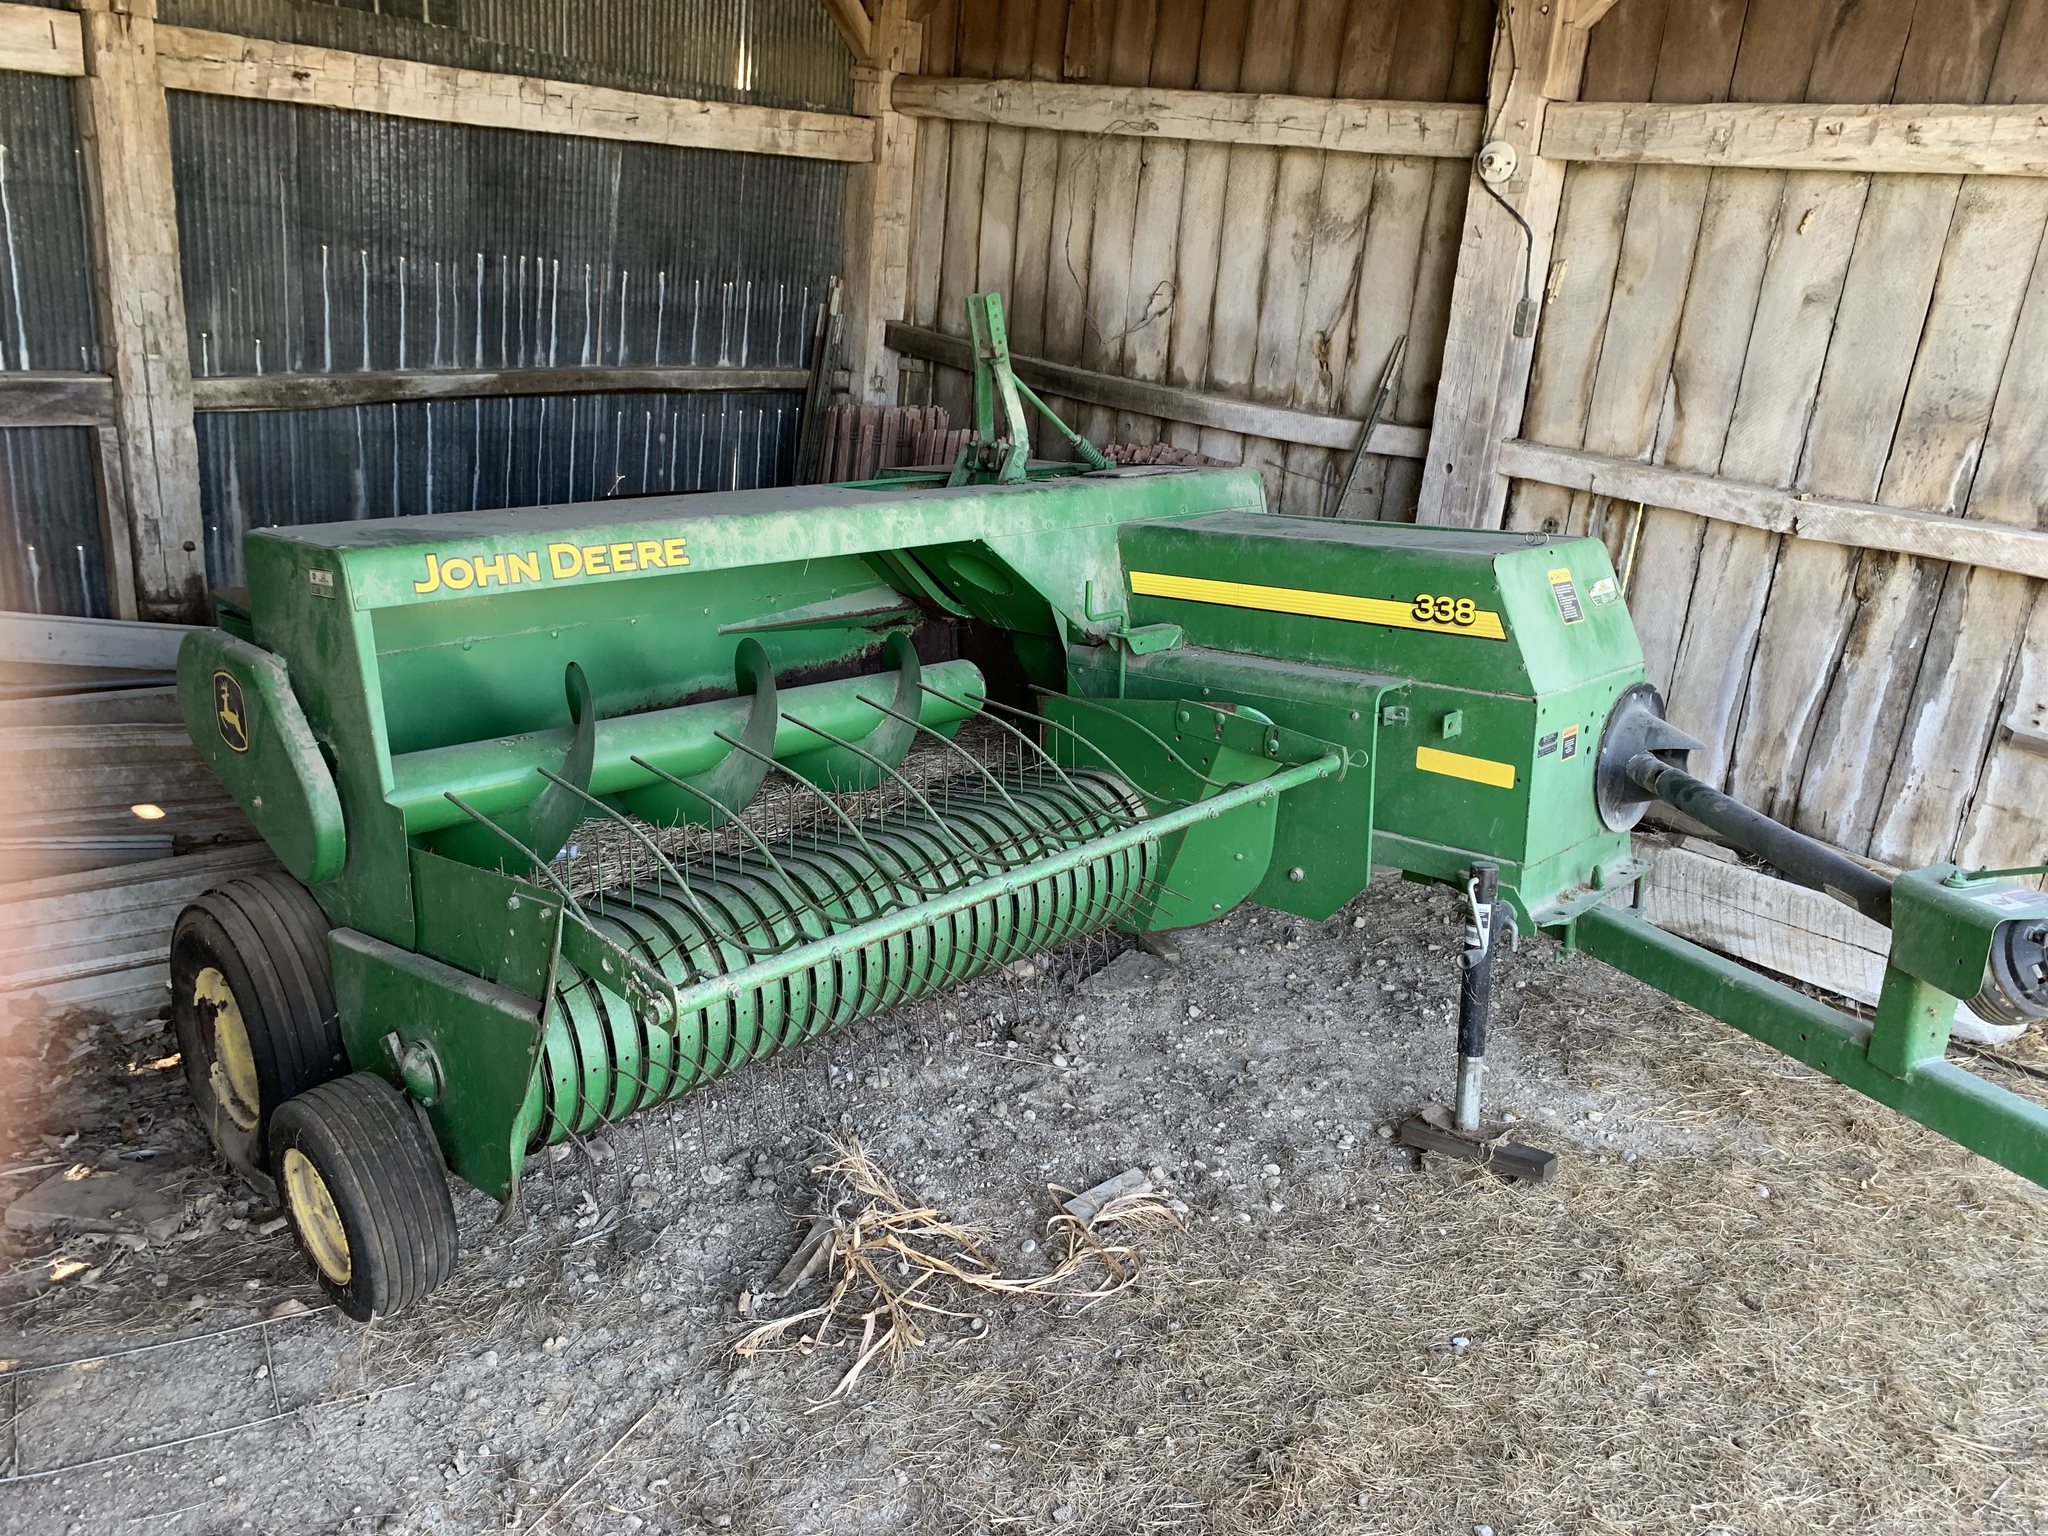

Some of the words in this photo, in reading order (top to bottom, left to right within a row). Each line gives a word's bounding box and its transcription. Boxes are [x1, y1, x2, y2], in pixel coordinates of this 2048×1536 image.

[413, 551, 542, 594] JOHN
[547, 537, 691, 580] DEERE
[1412, 593, 1476, 626] 338
